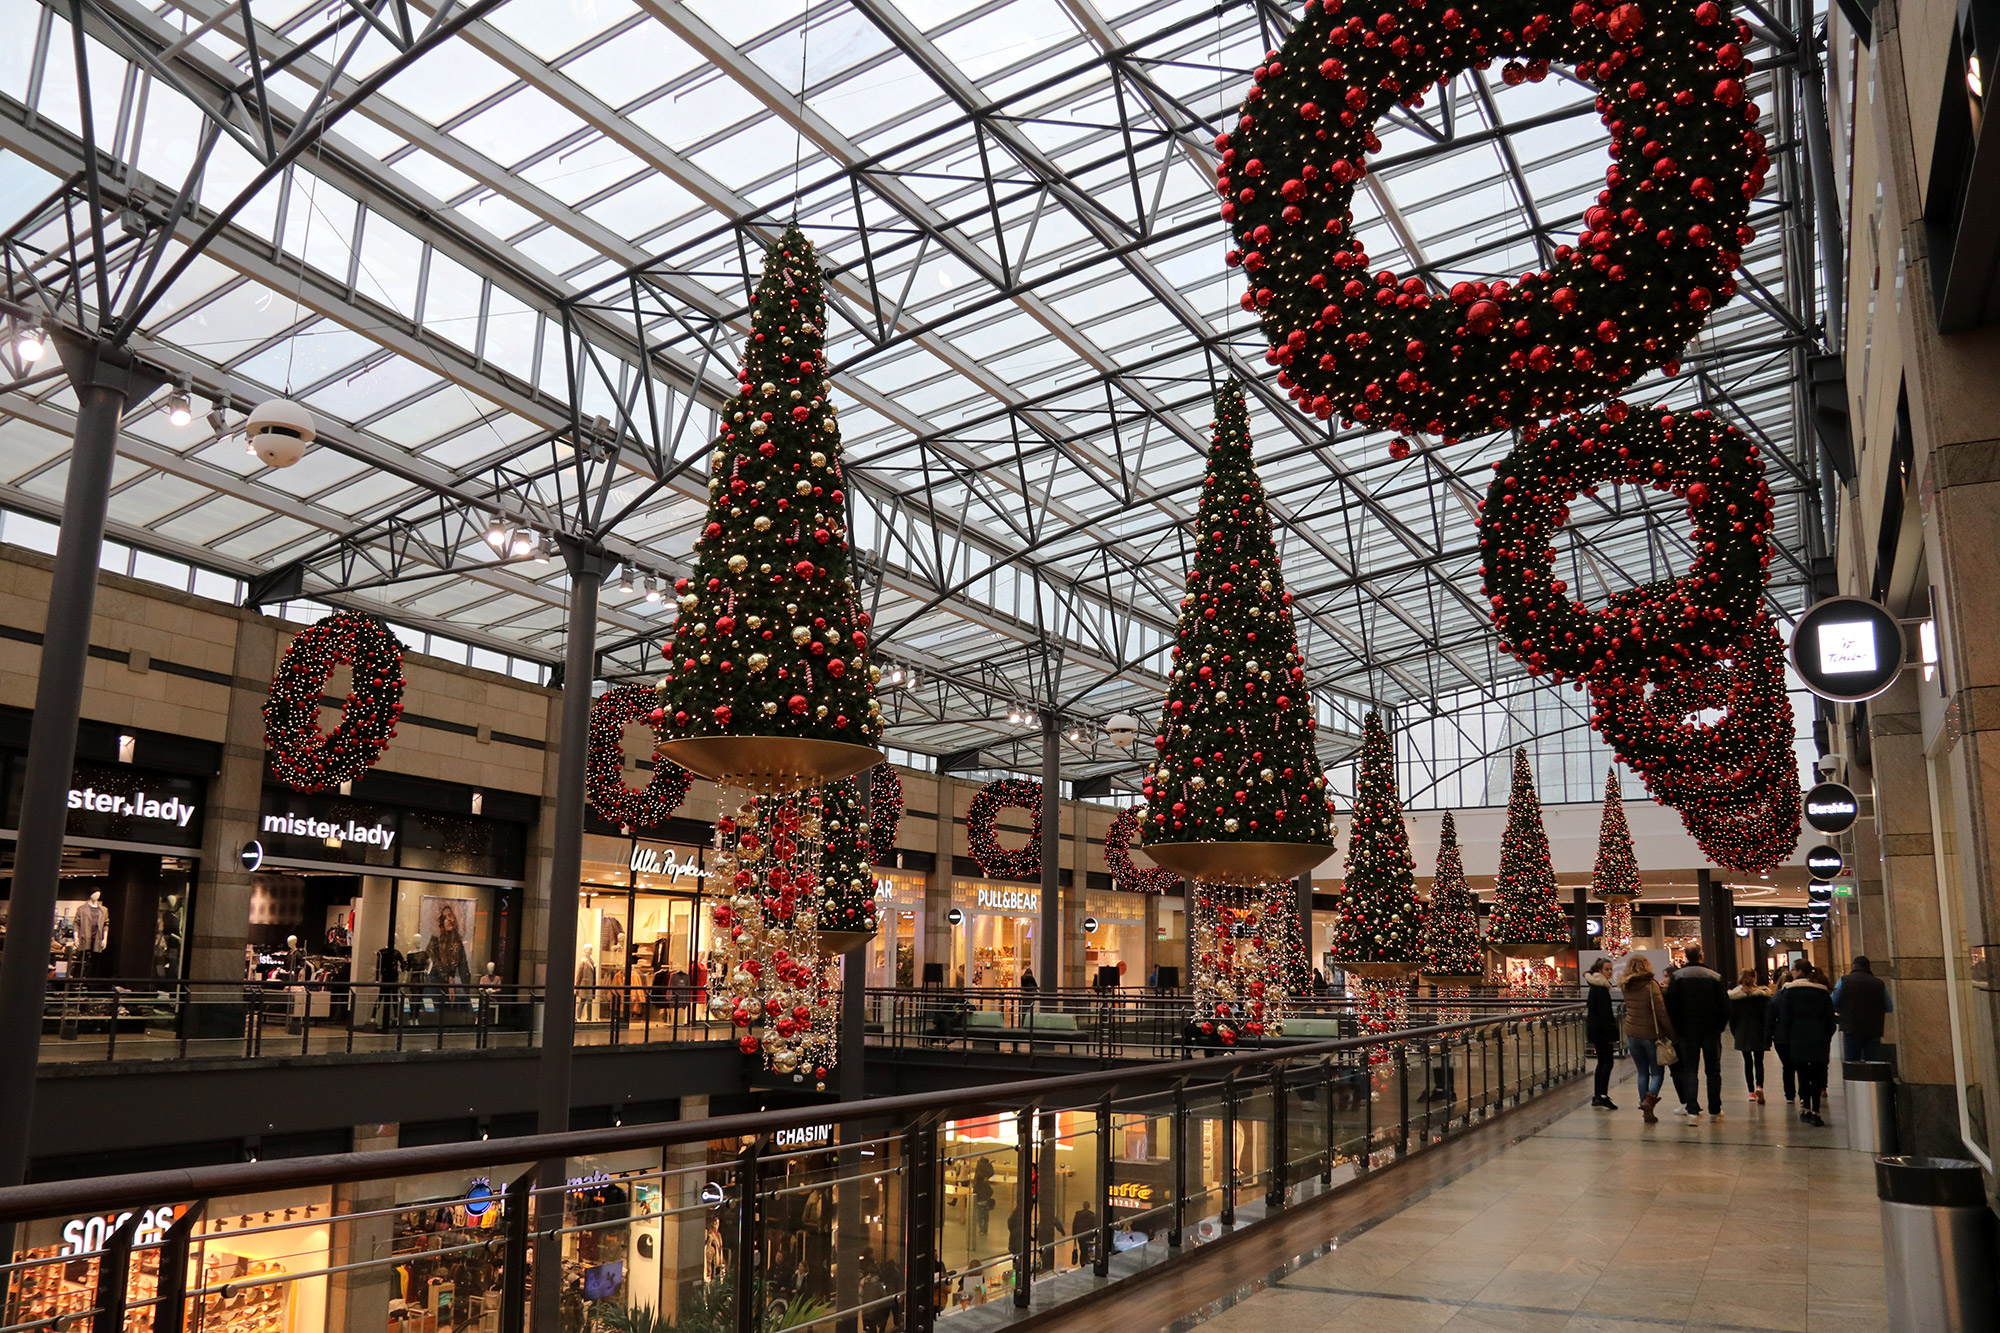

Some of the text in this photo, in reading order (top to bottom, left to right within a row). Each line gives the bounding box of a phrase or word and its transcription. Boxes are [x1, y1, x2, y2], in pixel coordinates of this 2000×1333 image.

[67, 787, 195, 827] ster lady
[263, 812, 395, 850] mister lady
[630, 845, 715, 884] Ulla Popken
[977, 889, 1038, 911] PULL&BEAR
[776, 1123, 833, 1146] CHASIN'
[565, 1170, 611, 1194] mato
[1108, 1183, 1153, 1200] affé
